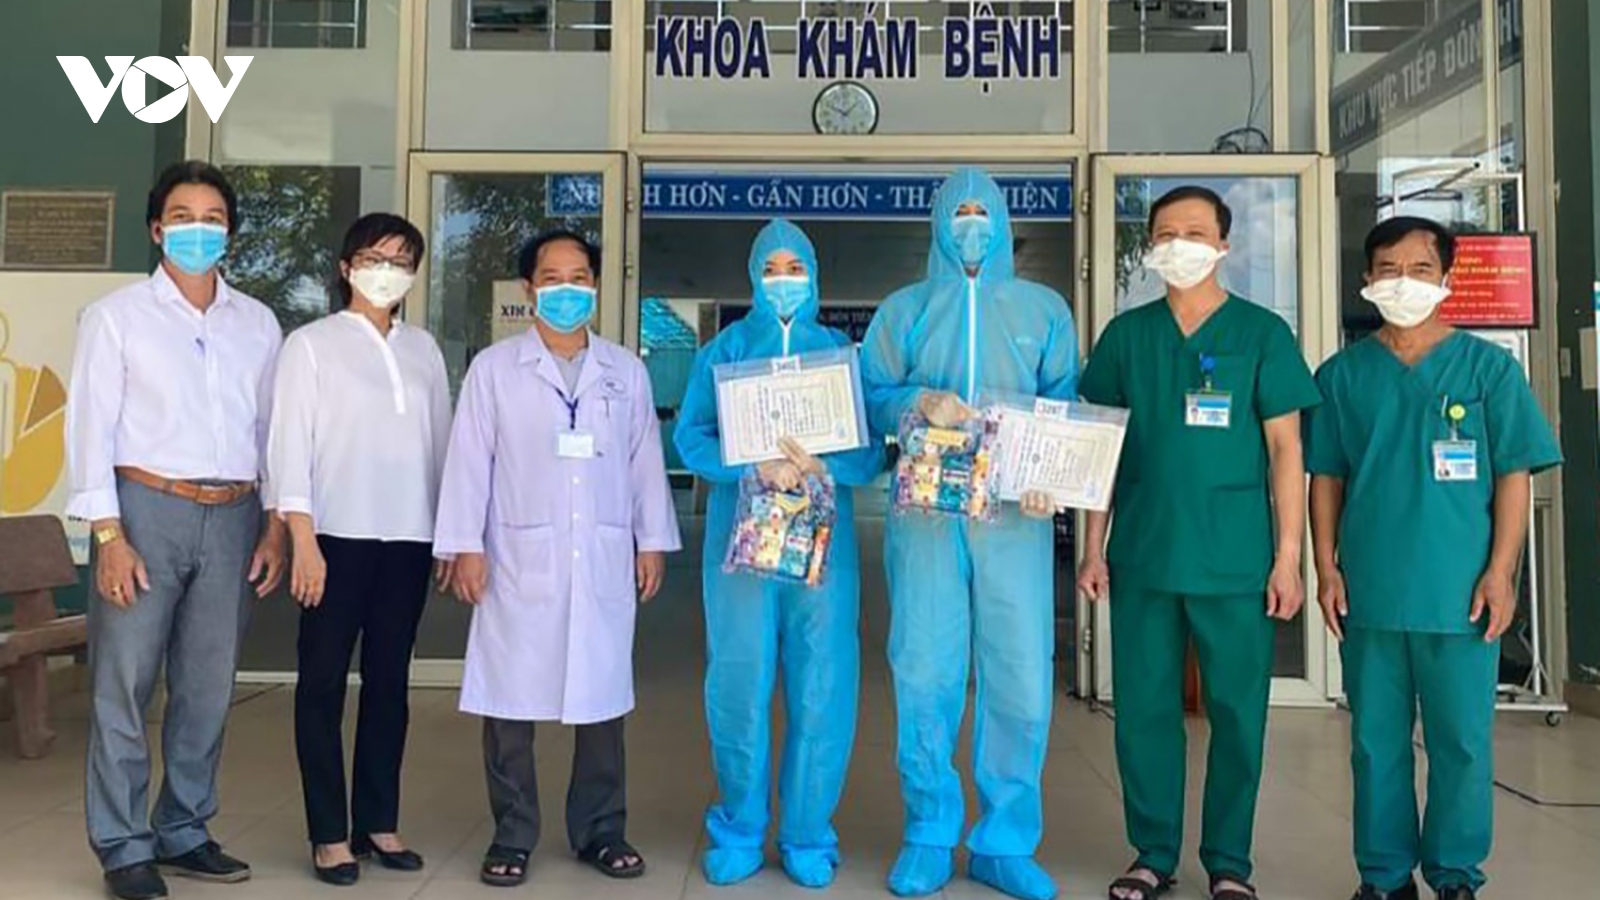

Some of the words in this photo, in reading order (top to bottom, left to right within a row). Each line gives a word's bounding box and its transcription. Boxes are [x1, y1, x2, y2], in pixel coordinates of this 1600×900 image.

[655, 16, 770, 78] KHOA
[798, 2, 917, 78] KHÁM
[945, 3, 1059, 93] BỆNH
[1338, 92, 1366, 139] KHU
[1401, 43, 1437, 102] TIẾP
[670, 181, 727, 208] HƠN
[812, 182, 869, 209] HƠN
